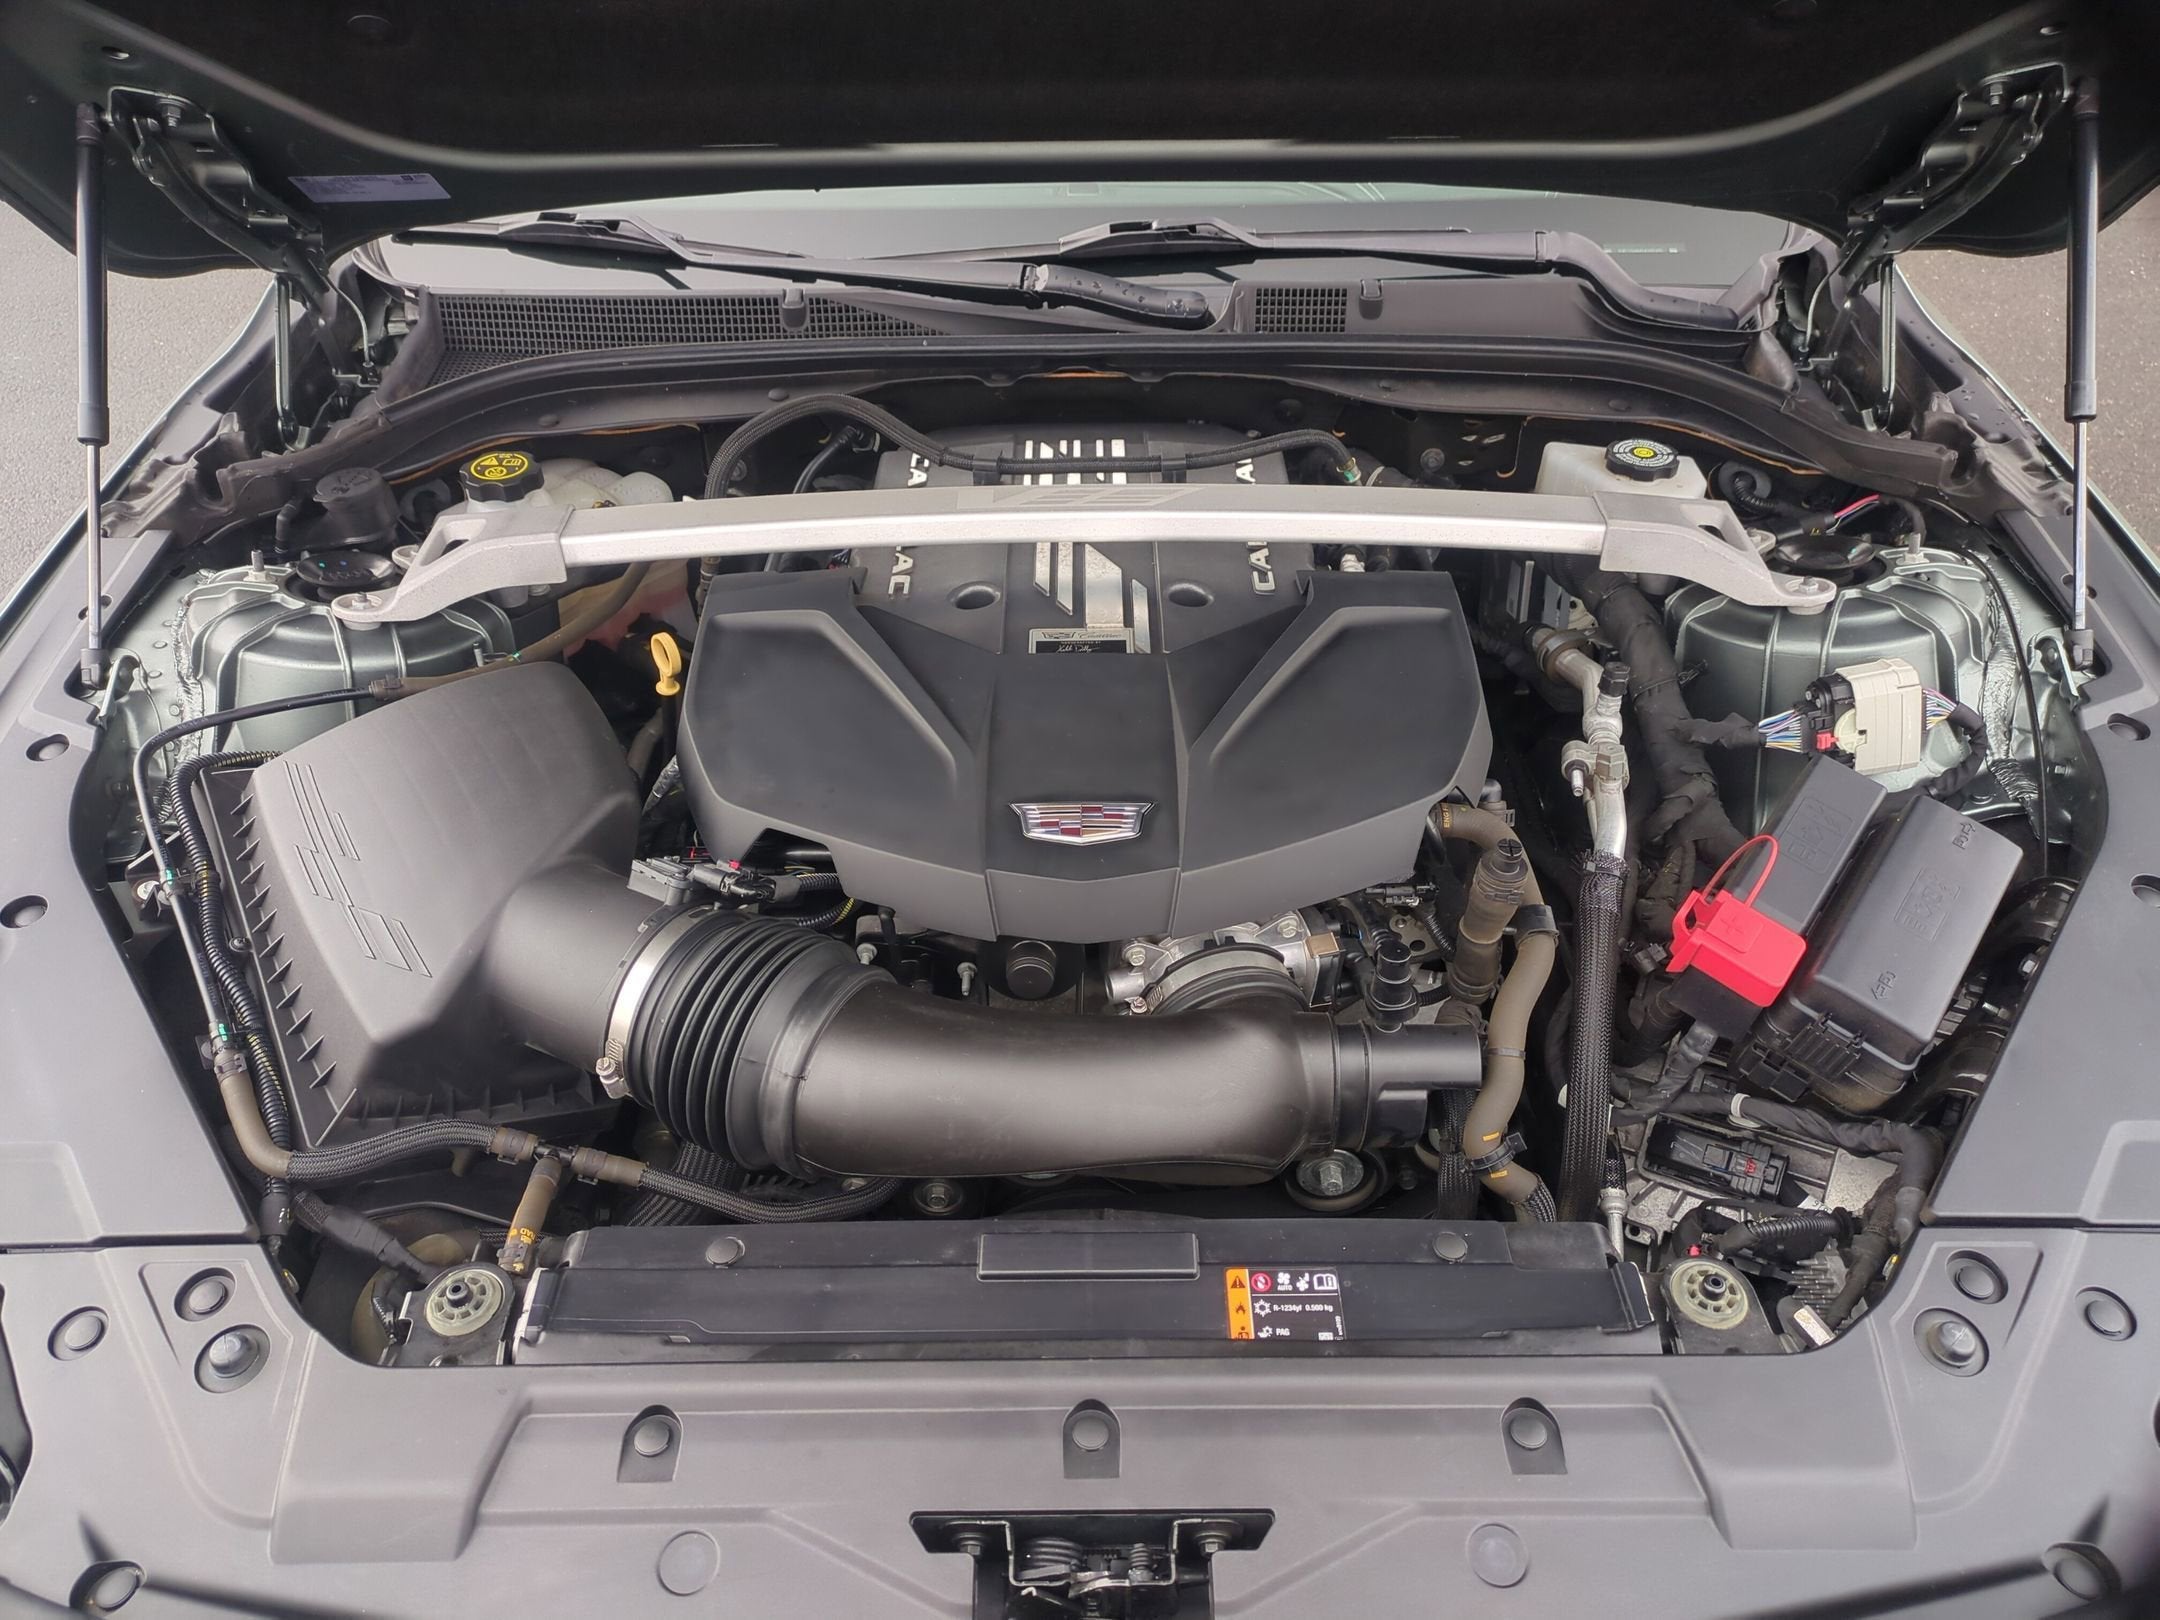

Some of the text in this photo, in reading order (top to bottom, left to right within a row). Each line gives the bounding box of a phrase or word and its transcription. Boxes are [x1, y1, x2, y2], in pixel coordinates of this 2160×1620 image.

[1273, 1303, 1302, 1313] R-1234yf
[1324, 1303, 1334, 1313] kg
[1276, 1327, 1290, 1336] PAG
